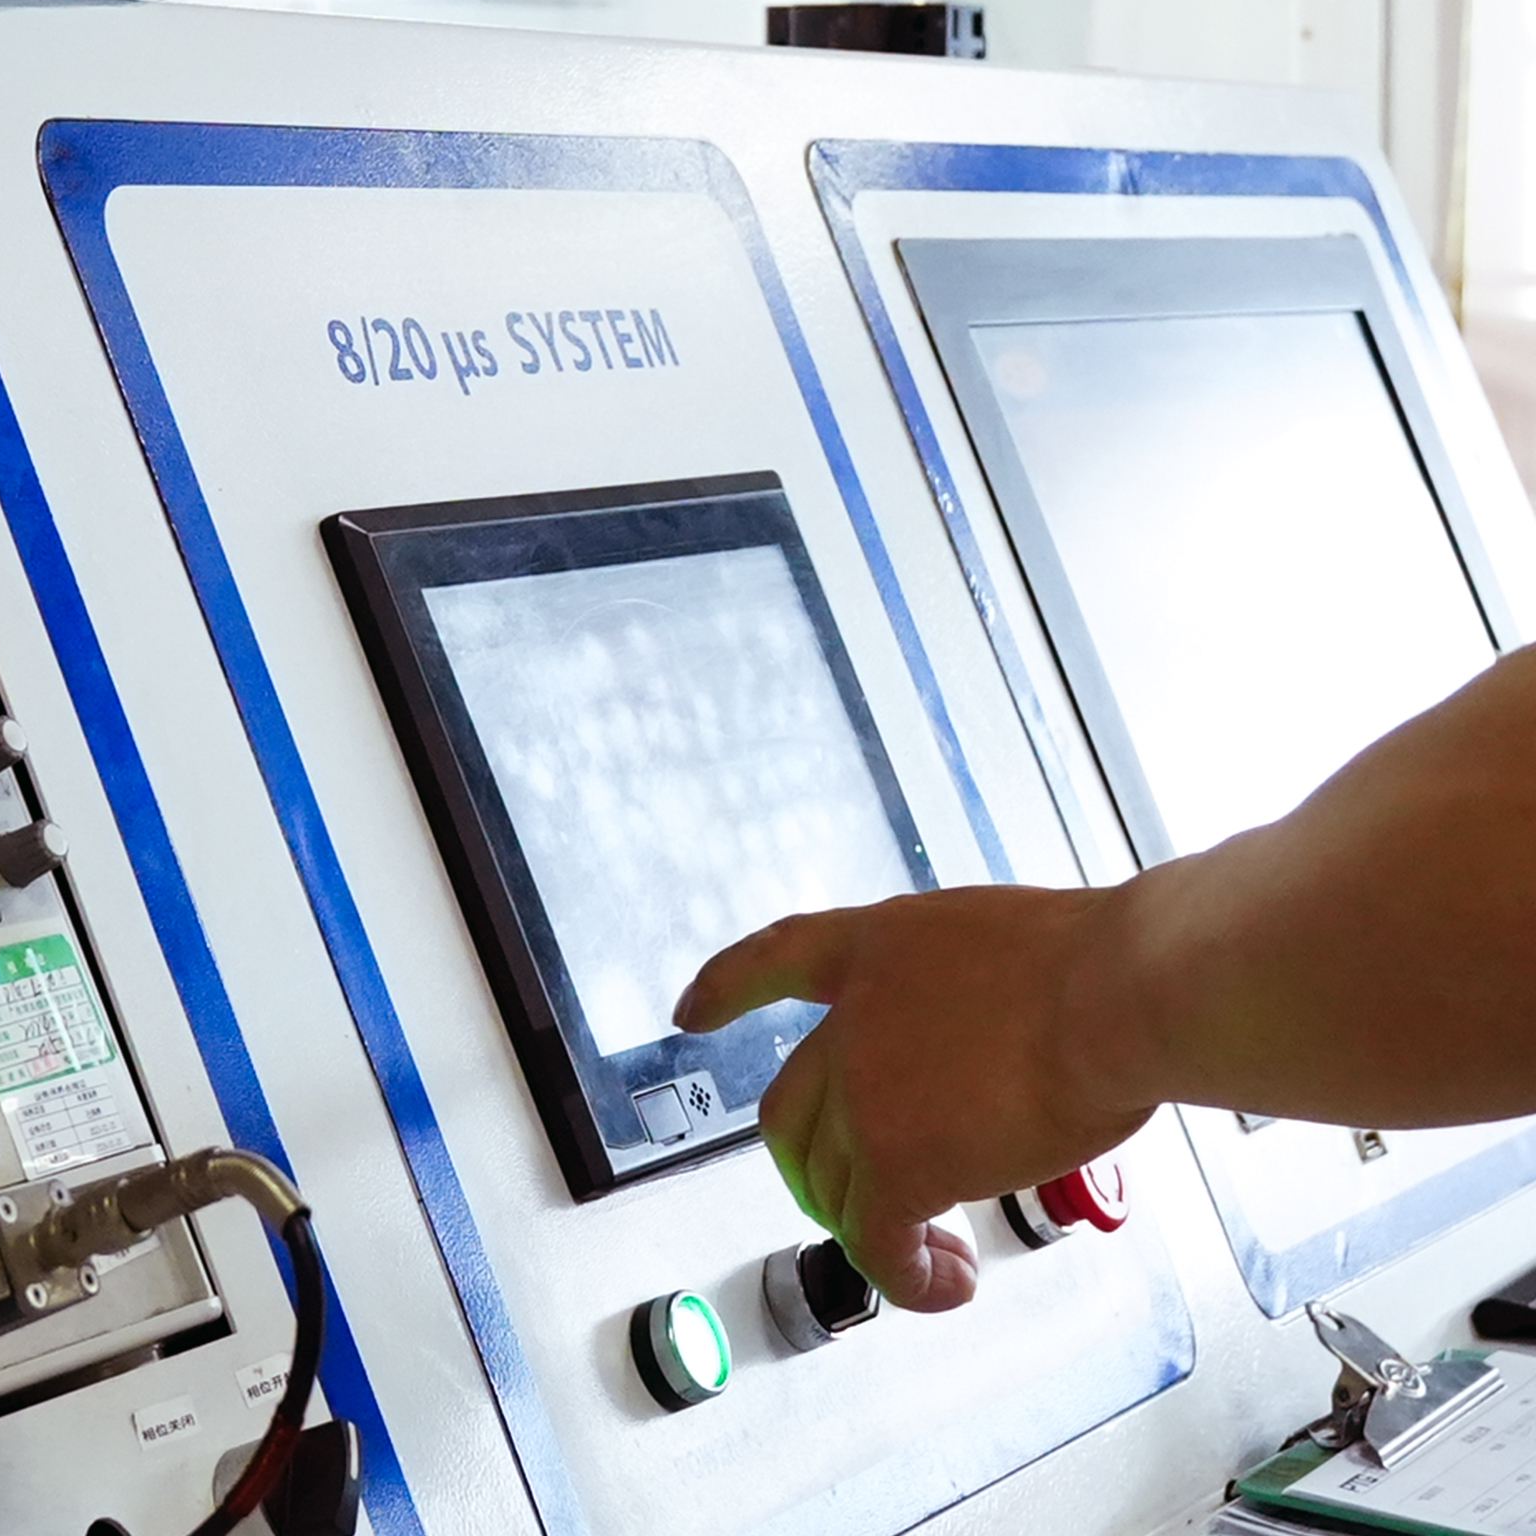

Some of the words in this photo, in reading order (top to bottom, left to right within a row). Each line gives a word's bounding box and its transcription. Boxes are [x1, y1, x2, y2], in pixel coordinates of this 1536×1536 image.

[326, 315, 437, 386] 8/20
[504, 308, 681, 375] SYSTEM
[246, 1371, 291, 1400] 相位开
[142, 1414, 196, 1442] 相位关闭
